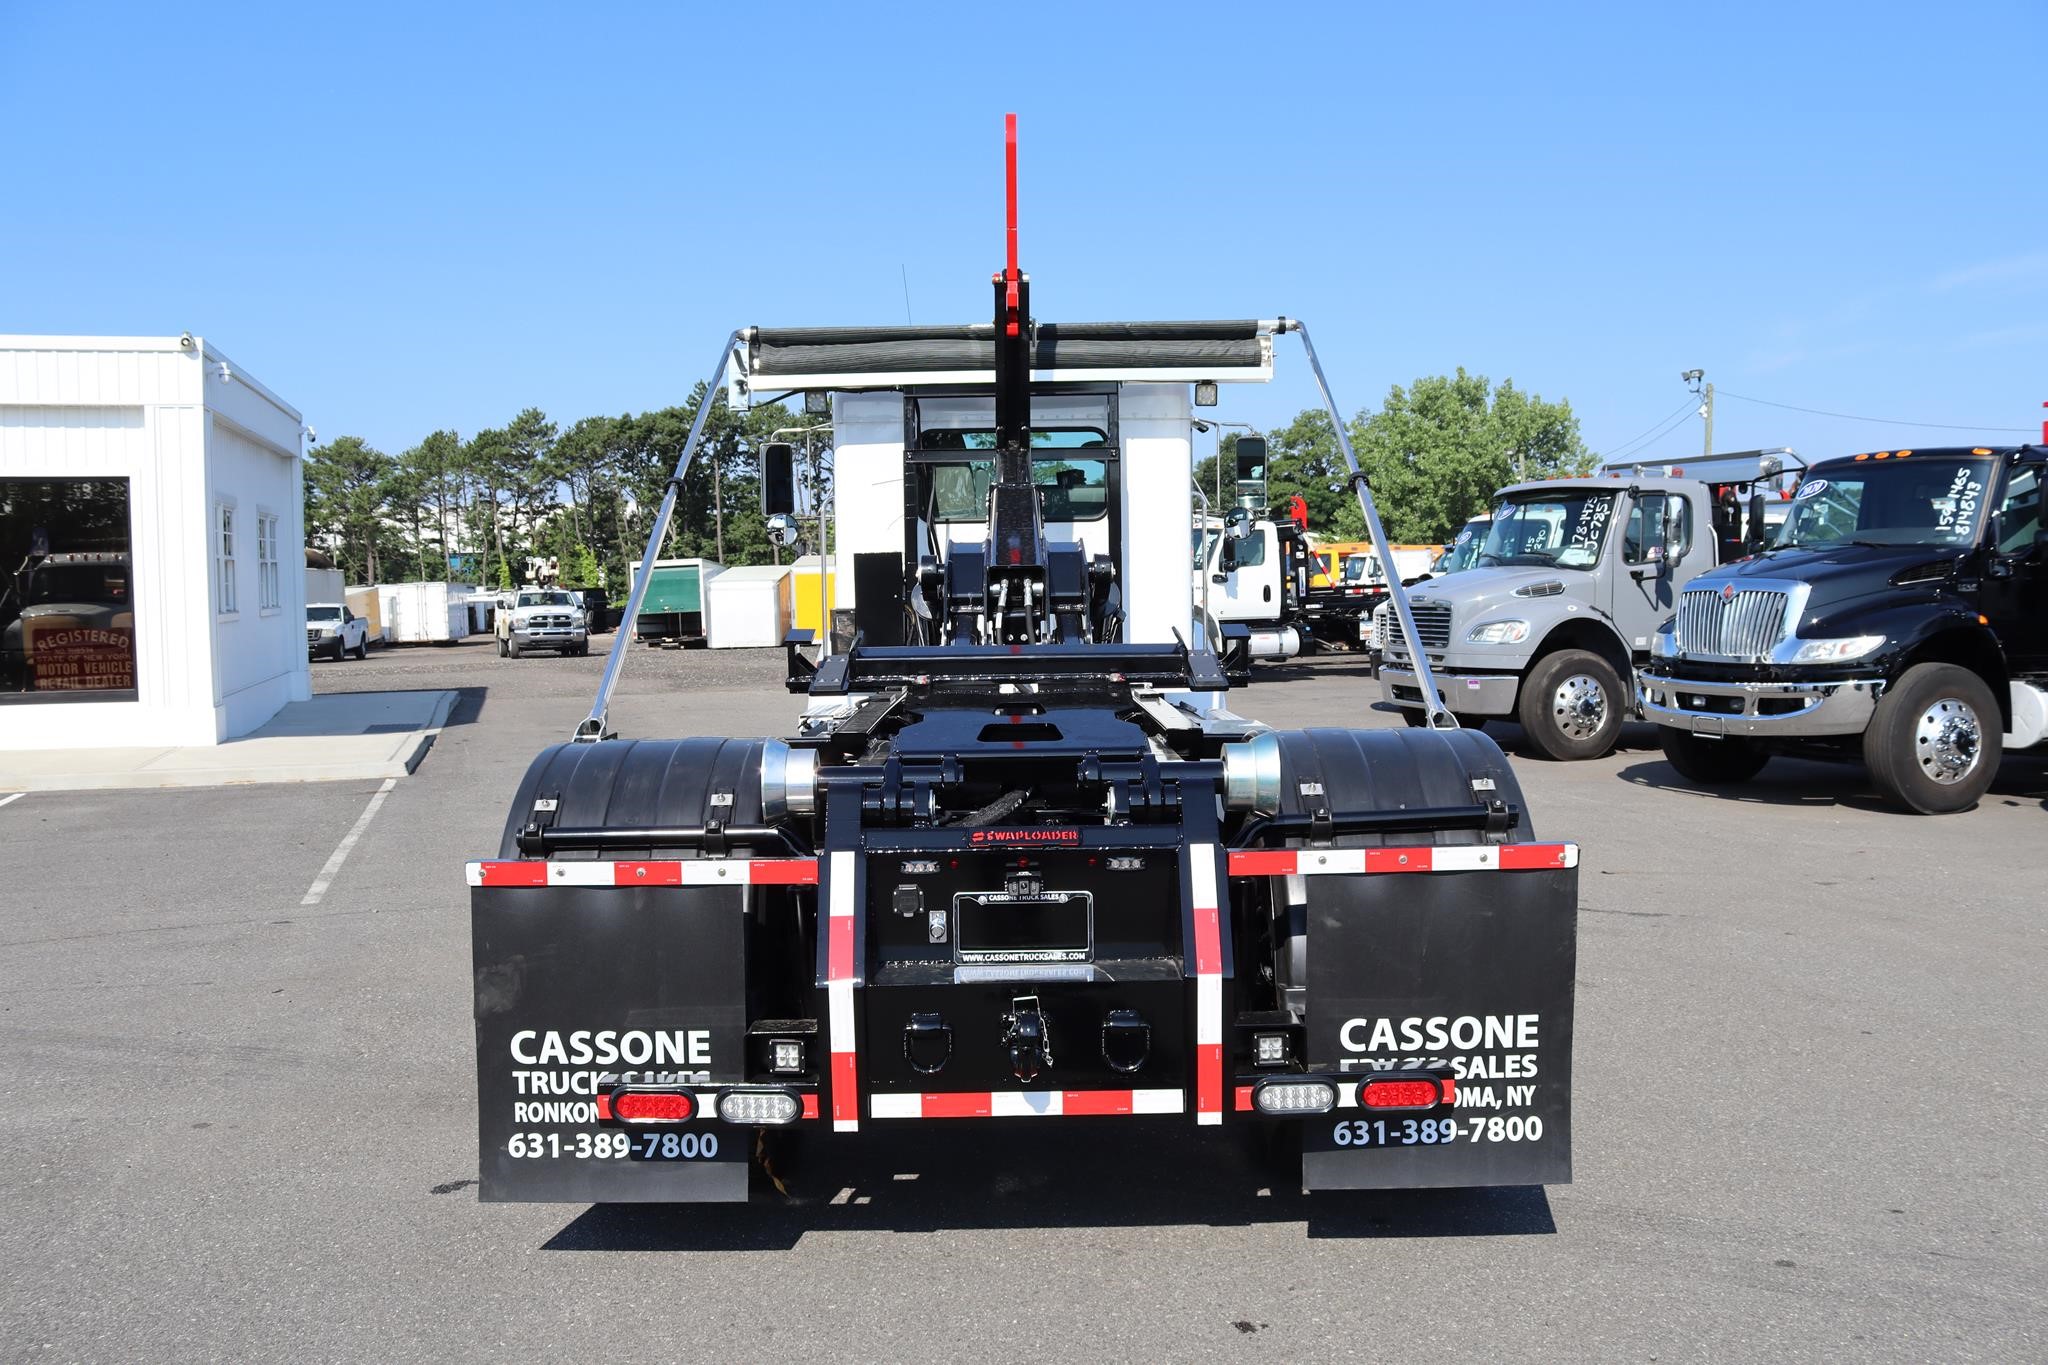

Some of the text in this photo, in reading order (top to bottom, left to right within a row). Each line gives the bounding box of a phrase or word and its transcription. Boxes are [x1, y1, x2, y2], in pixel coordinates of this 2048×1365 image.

[1955, 481, 1982, 535] 814843
[37, 630, 129, 652] REGISTERED
[37, 661, 131, 676] MOTOR VEHICLE
[40, 675, 131, 689] RETAIL DEALER
[962, 952, 1086, 962] WWW.CASSONETRUCKSALES.COM
[1339, 1014, 1540, 1052] CASSONE
[510, 1030, 712, 1065] CASSONE
[1507, 1085, 1537, 1107] NY
[1333, 1115, 1544, 1146] 631-389-7800
[507, 1133, 718, 1159] 631-389-7800
